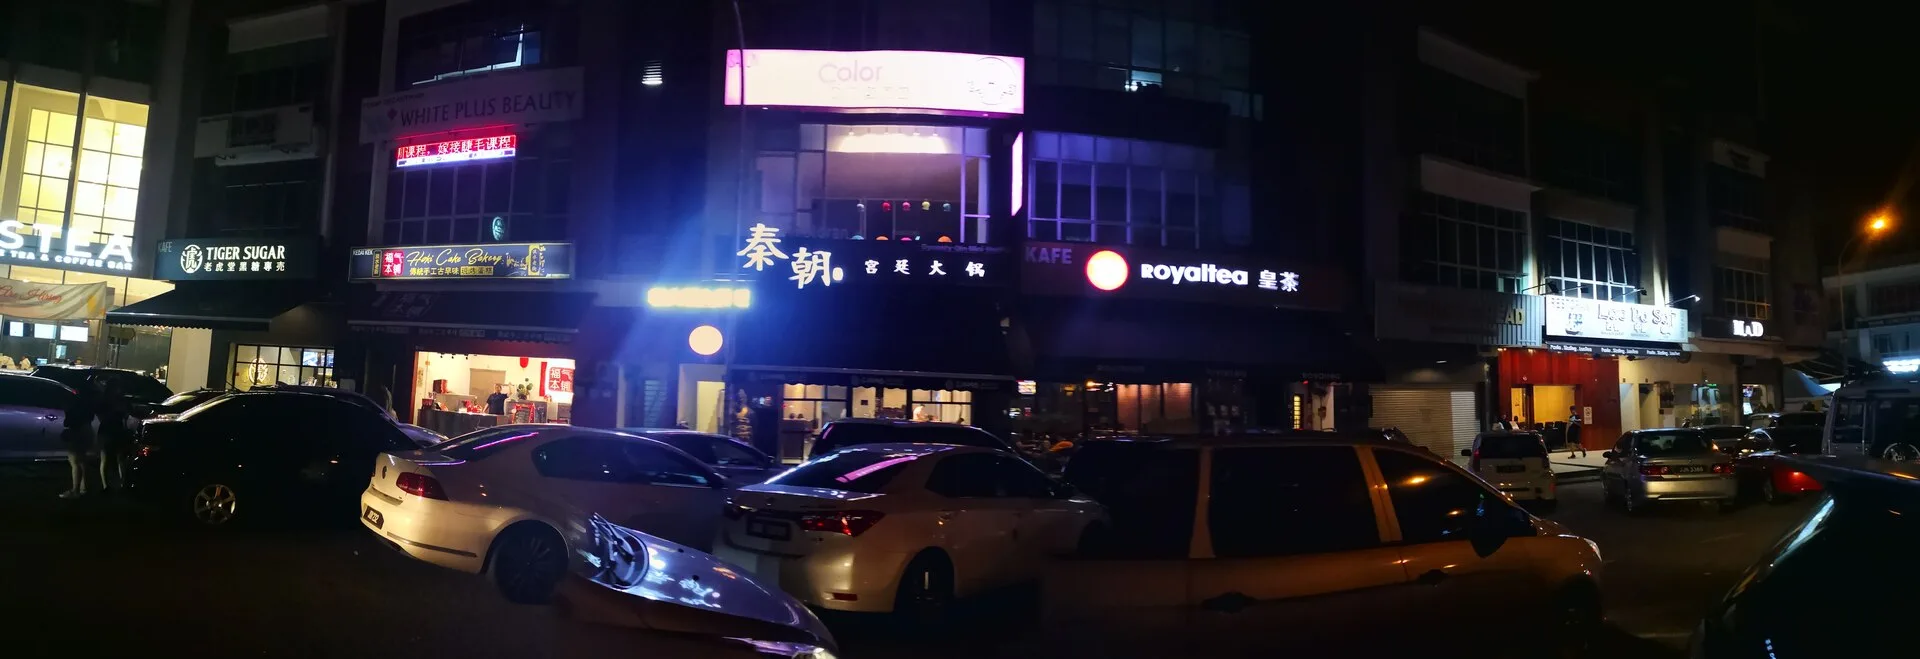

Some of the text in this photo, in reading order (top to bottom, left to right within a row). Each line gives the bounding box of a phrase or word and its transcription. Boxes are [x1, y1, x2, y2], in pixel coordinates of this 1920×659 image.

[818, 60, 883, 83] Color
[400, 91, 577, 127] WHITE PLUS BEAUTY
[158, 241, 173, 252] KAFE
[206, 245, 286, 260] TIGER SUGAR
[54, 254, 104, 268] COFFEE
[436, 248, 461, 266] Cake
[465, 248, 502, 265] Bakery
[1025, 247, 1073, 264] KAFE
[1258, 269, 1300, 292] 皇茶
